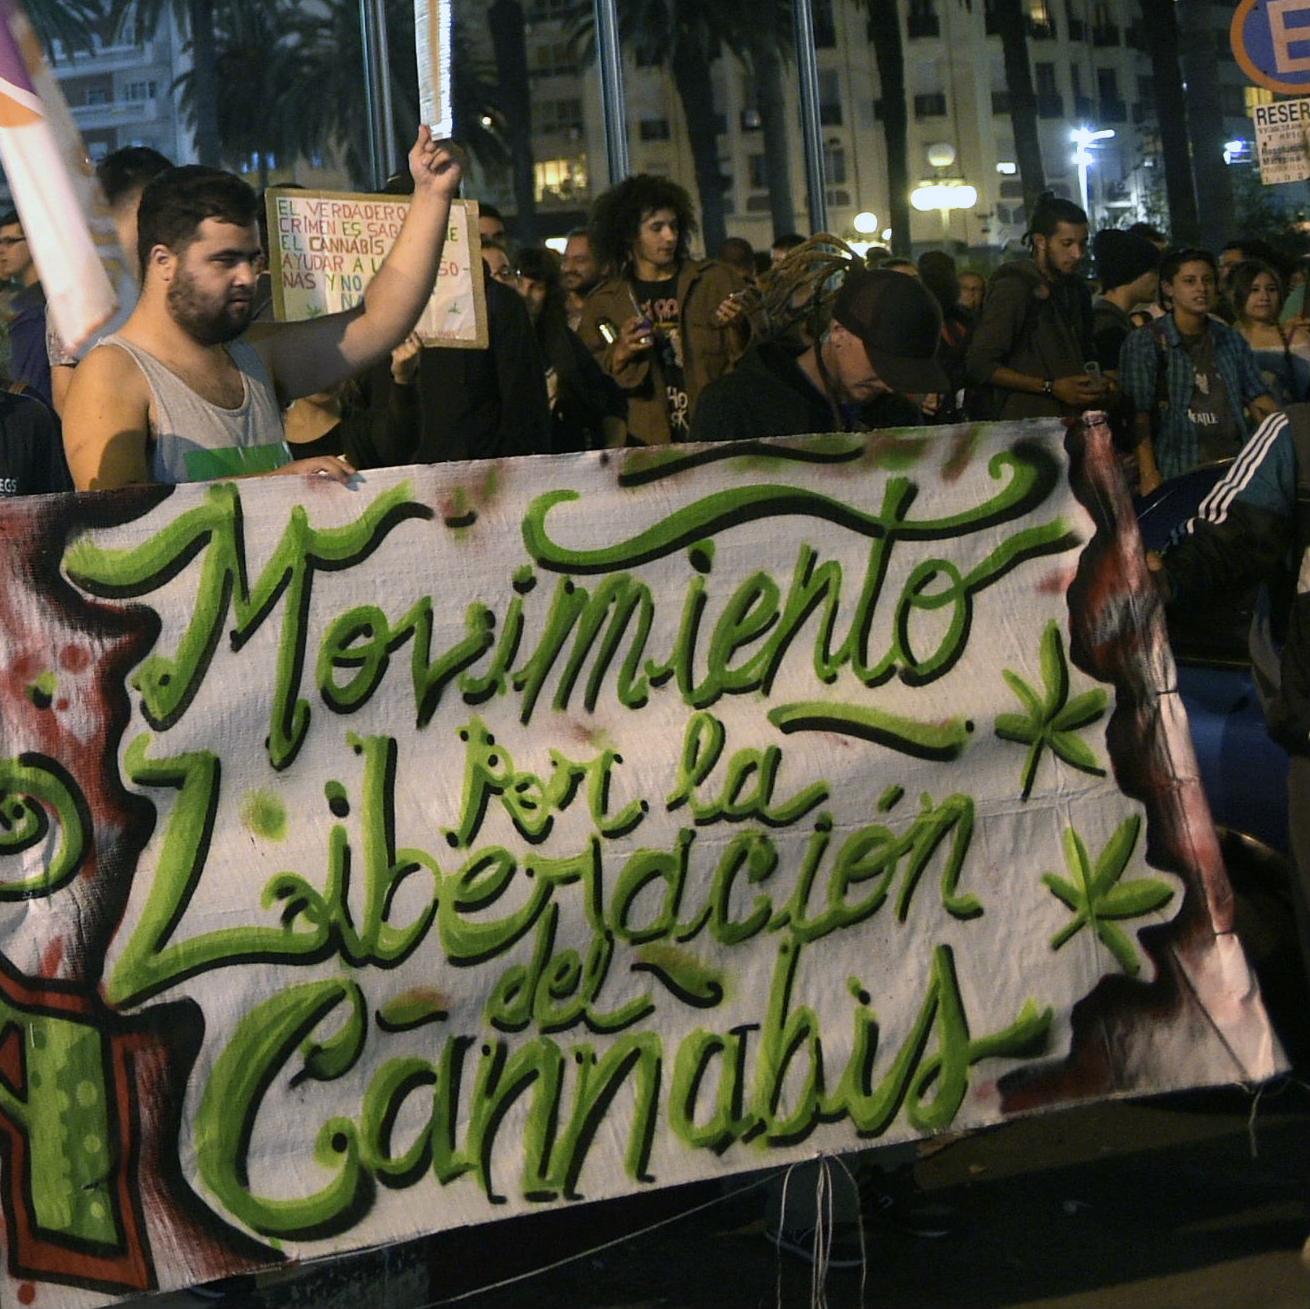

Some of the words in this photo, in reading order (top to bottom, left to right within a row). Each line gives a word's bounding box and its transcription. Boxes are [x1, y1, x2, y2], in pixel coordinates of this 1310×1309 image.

[278, 199, 300, 217] EL
[306, 200, 407, 222] VERDADERO
[281, 234, 303, 252] EL
[342, 221, 361, 237] ES
[283, 253, 345, 272] AYUDAR
[353, 257, 364, 273] A
[283, 272, 317, 290] NAS
[325, 273, 335, 291] Y
[341, 274, 363, 292] NO
[64, 477, 1084, 770] Movimiento
[665, 710, 831, 828] la
[107, 732, 983, 1010] Liberación
[487, 900, 655, 1034] del
[193, 942, 1053, 1242] Cannabis
